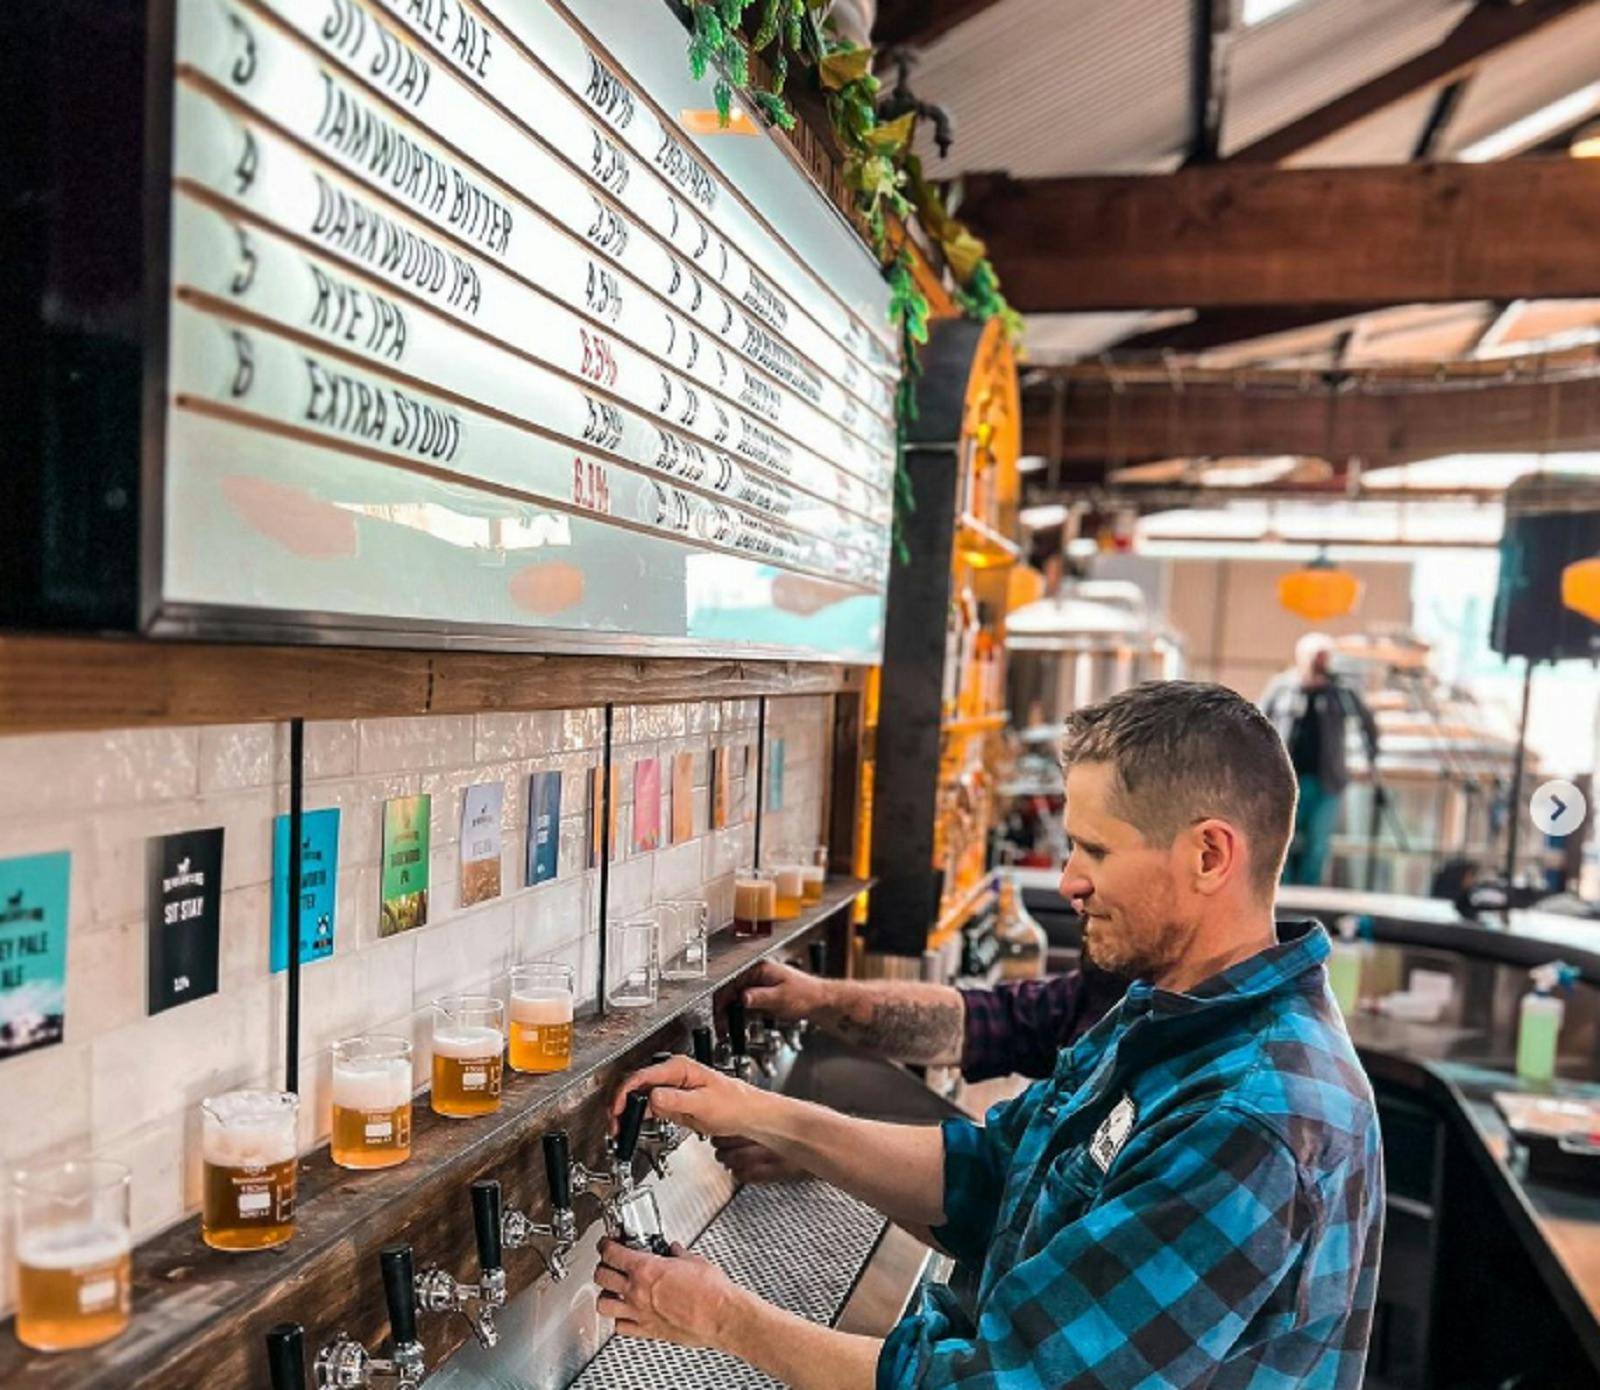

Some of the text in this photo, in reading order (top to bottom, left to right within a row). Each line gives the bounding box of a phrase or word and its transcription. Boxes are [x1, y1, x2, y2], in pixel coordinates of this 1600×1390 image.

[370, 16, 431, 107] STAY
[451, 2, 492, 78] ALE
[585, 52, 634, 129] ABV%
[315, 68, 447, 215] TAMWORTH
[448, 167, 514, 257] BITTER
[234, 127, 481, 316] 4 DARKWOOD IPA
[307, 262, 363, 341] RYE
[365, 292, 408, 362] IPA
[229, 328, 461, 462] 6 EXTRA STOUT
[574, 456, 610, 514] 6.1%
[18, 931, 48, 956] PALE
[181, 896, 204, 920] STAY
[1, 965, 22, 989] ALE
